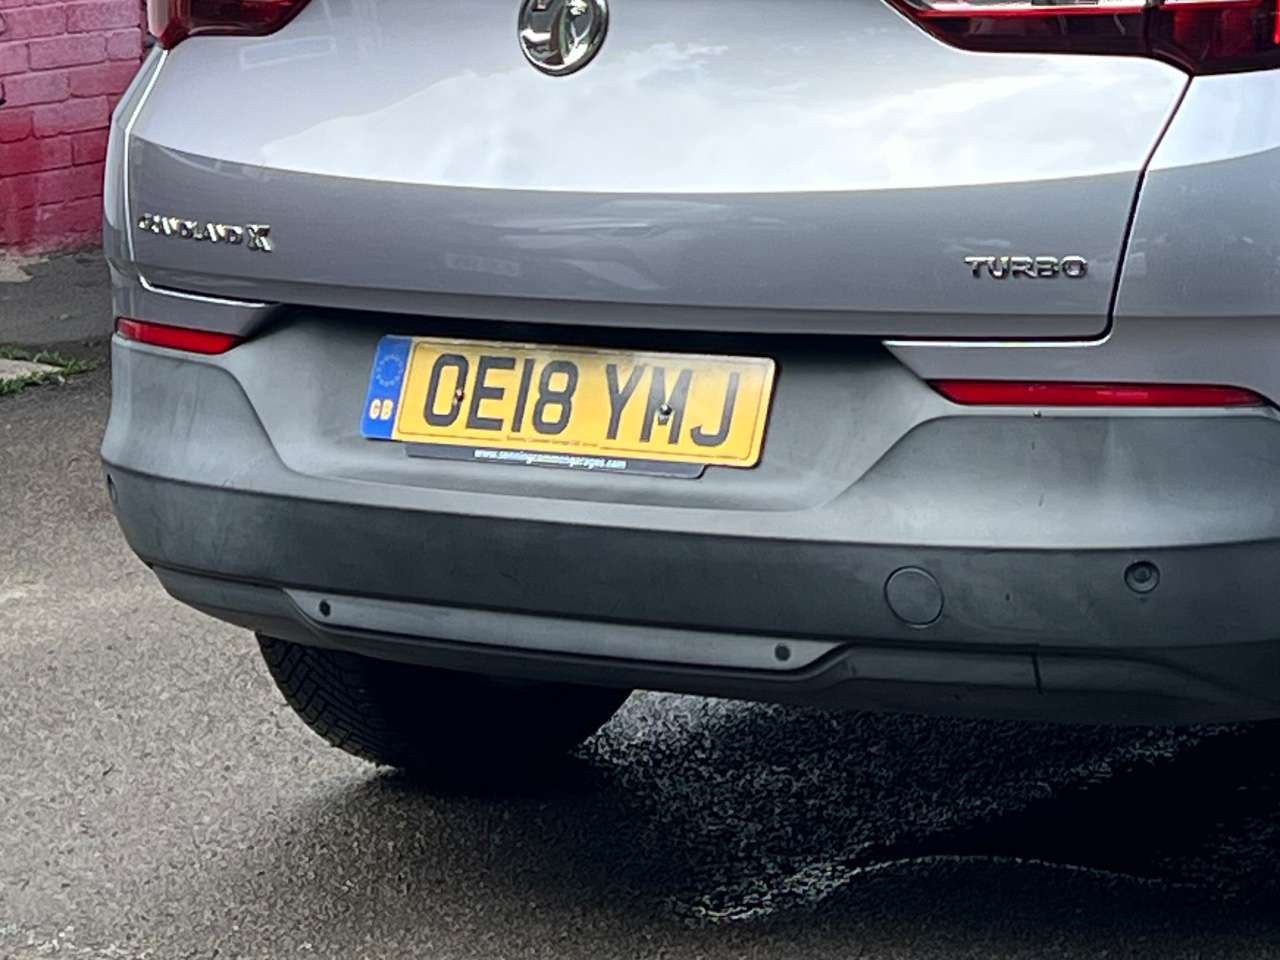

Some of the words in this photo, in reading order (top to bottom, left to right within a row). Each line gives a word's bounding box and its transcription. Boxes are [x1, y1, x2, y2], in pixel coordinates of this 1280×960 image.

[963, 255, 1089, 279] TURBO
[369, 398, 393, 420] GB
[422, 352, 580, 436] OE18
[605, 363, 740, 448] YMJ
